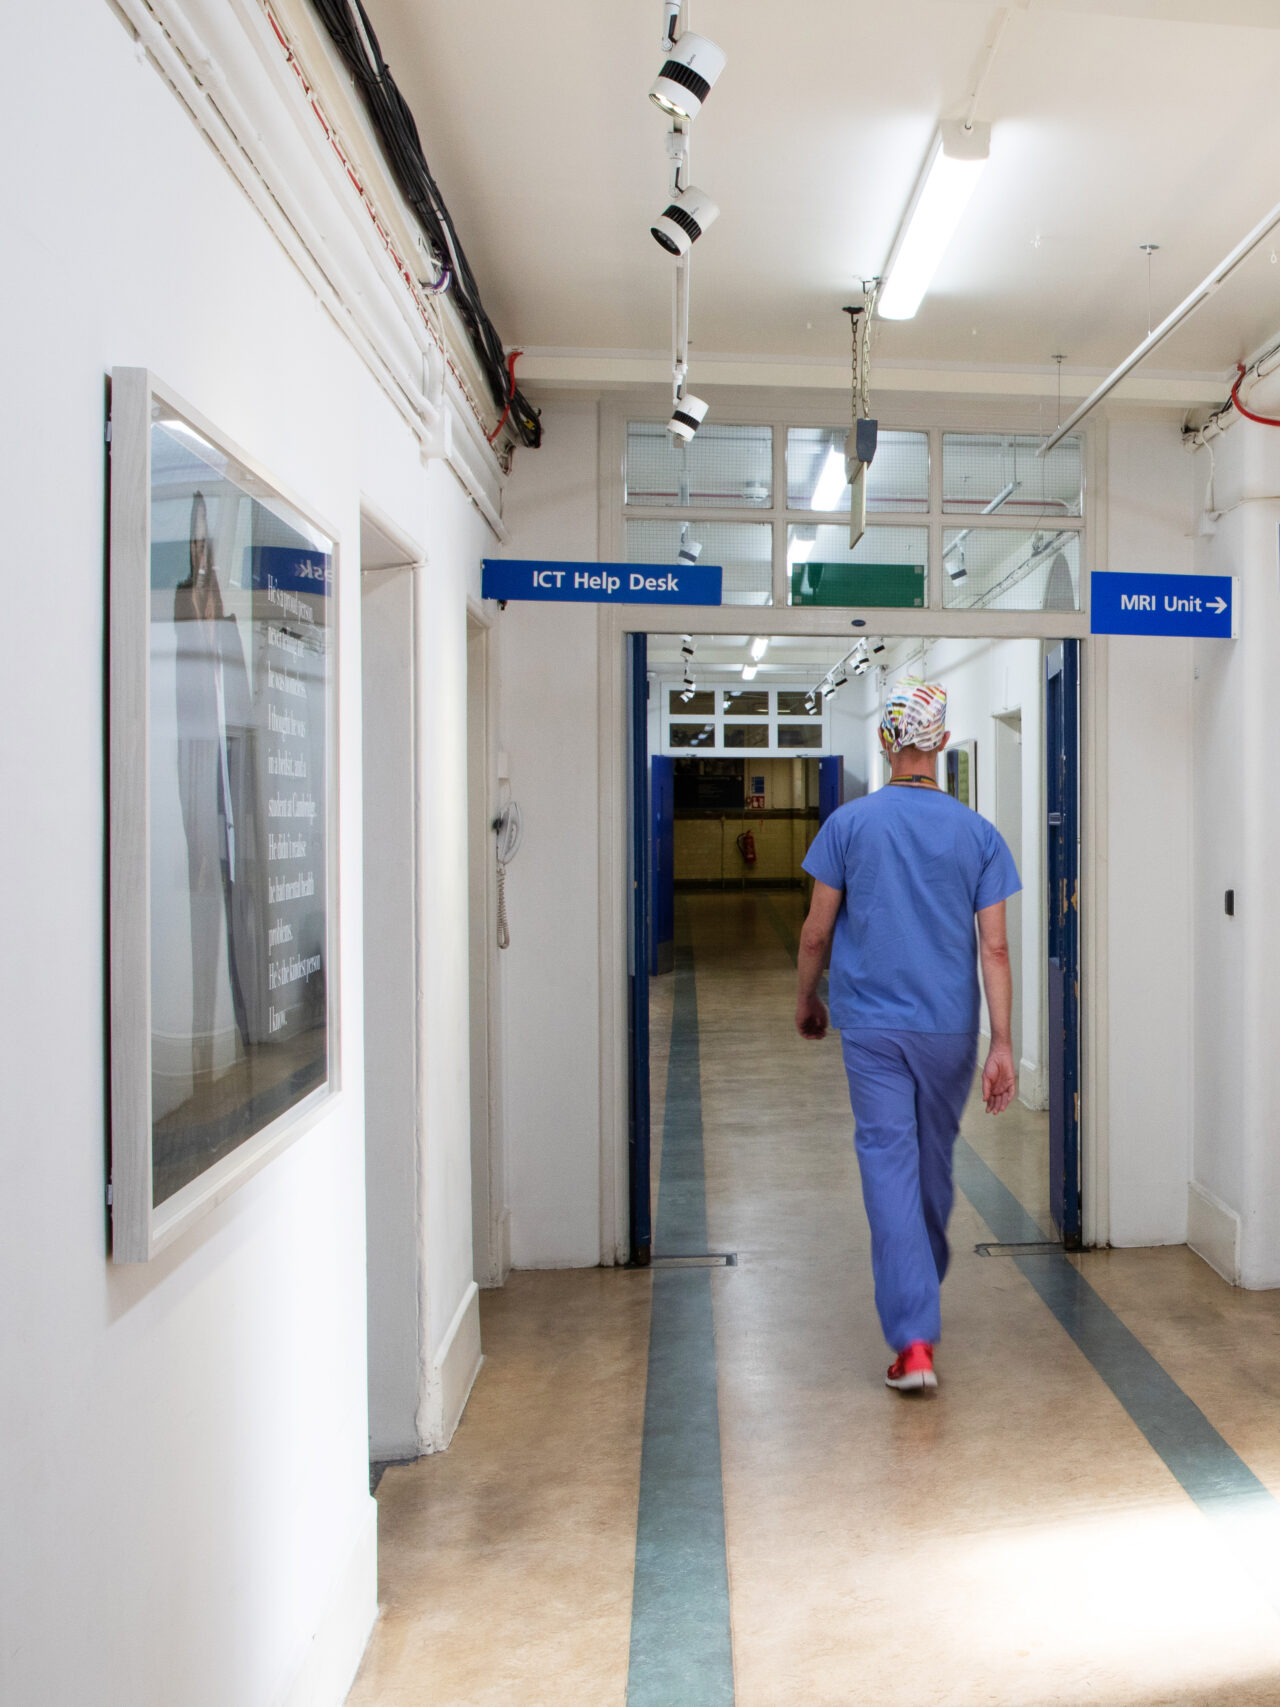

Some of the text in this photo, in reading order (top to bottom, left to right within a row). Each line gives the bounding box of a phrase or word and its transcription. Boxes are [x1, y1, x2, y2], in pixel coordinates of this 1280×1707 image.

[533, 571, 679, 593] ICT Help Desk
[1121, 595, 1202, 612] MRI Unit
